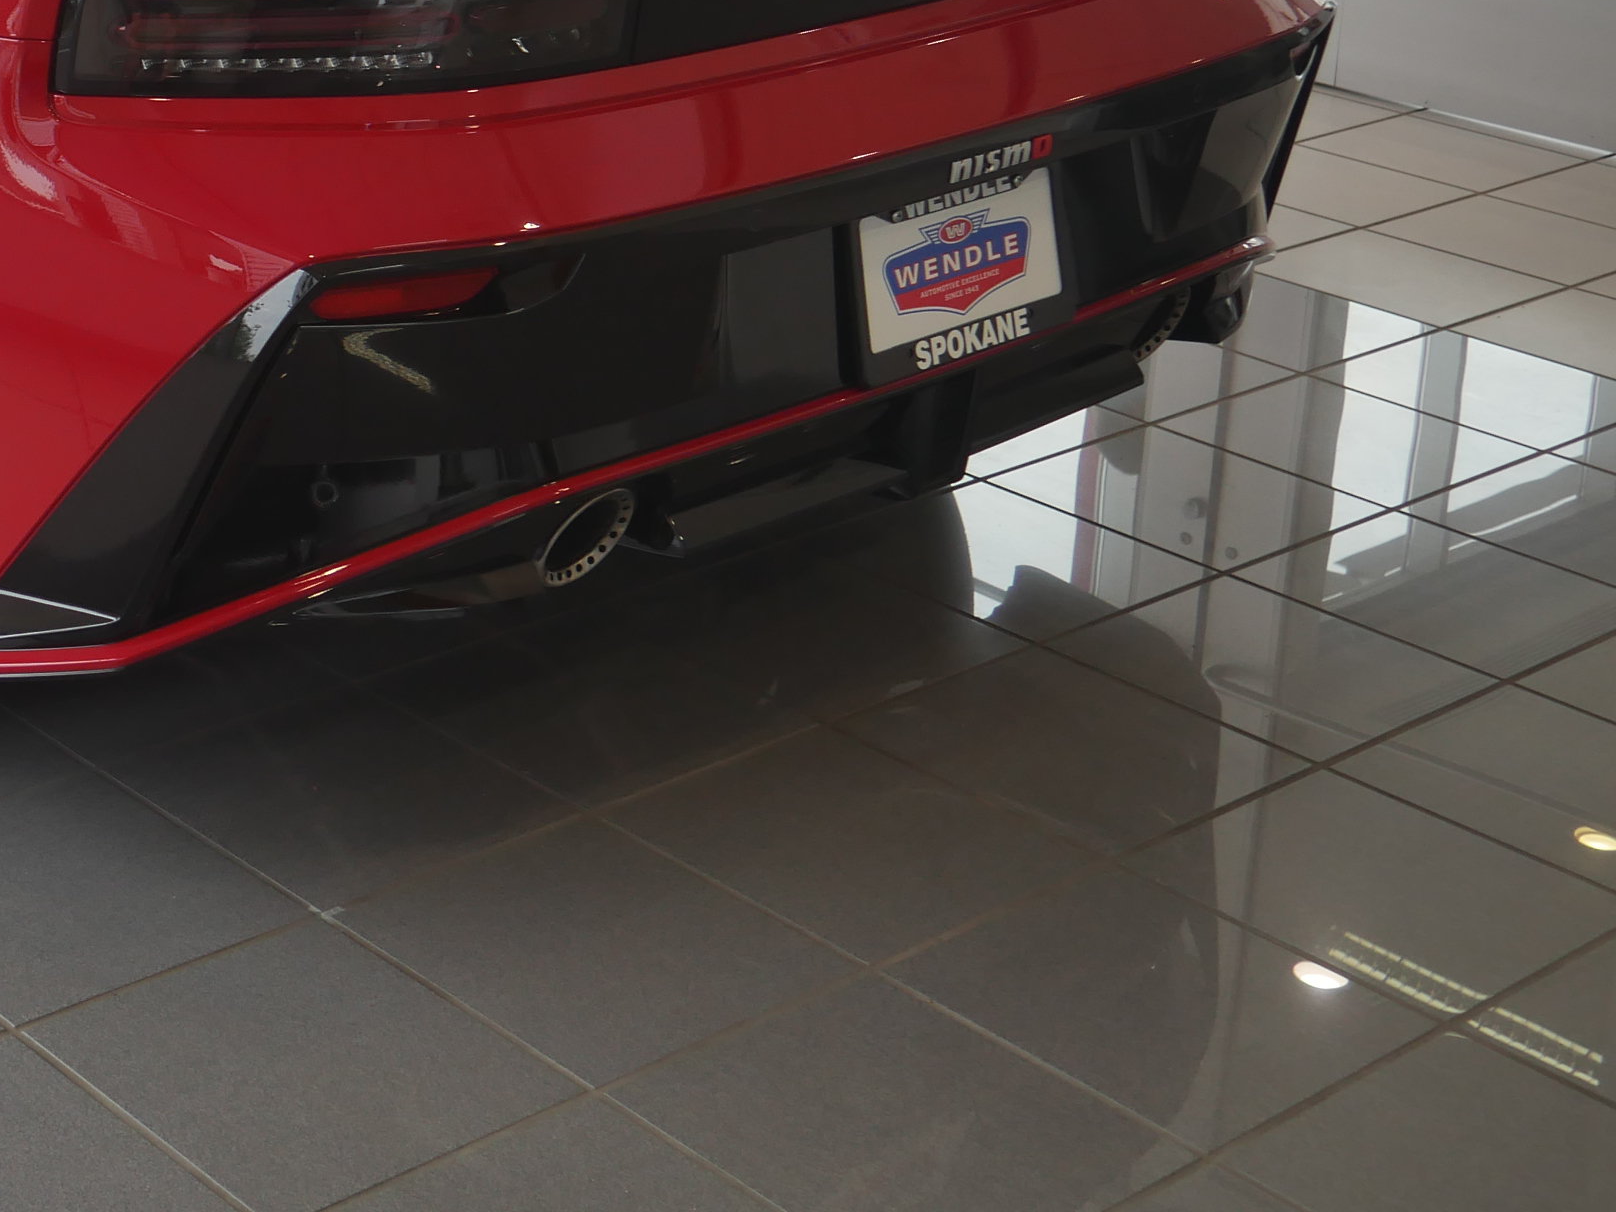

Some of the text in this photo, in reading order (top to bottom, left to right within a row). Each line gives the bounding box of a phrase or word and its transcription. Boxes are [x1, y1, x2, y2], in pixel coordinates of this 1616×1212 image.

[894, 233, 1019, 289] WENDLE
[920, 268, 1000, 299] AUTOMOTIVE EXCELLENCE
[944, 290, 964, 302] SINCE
[915, 307, 1031, 370] SPOKANE
